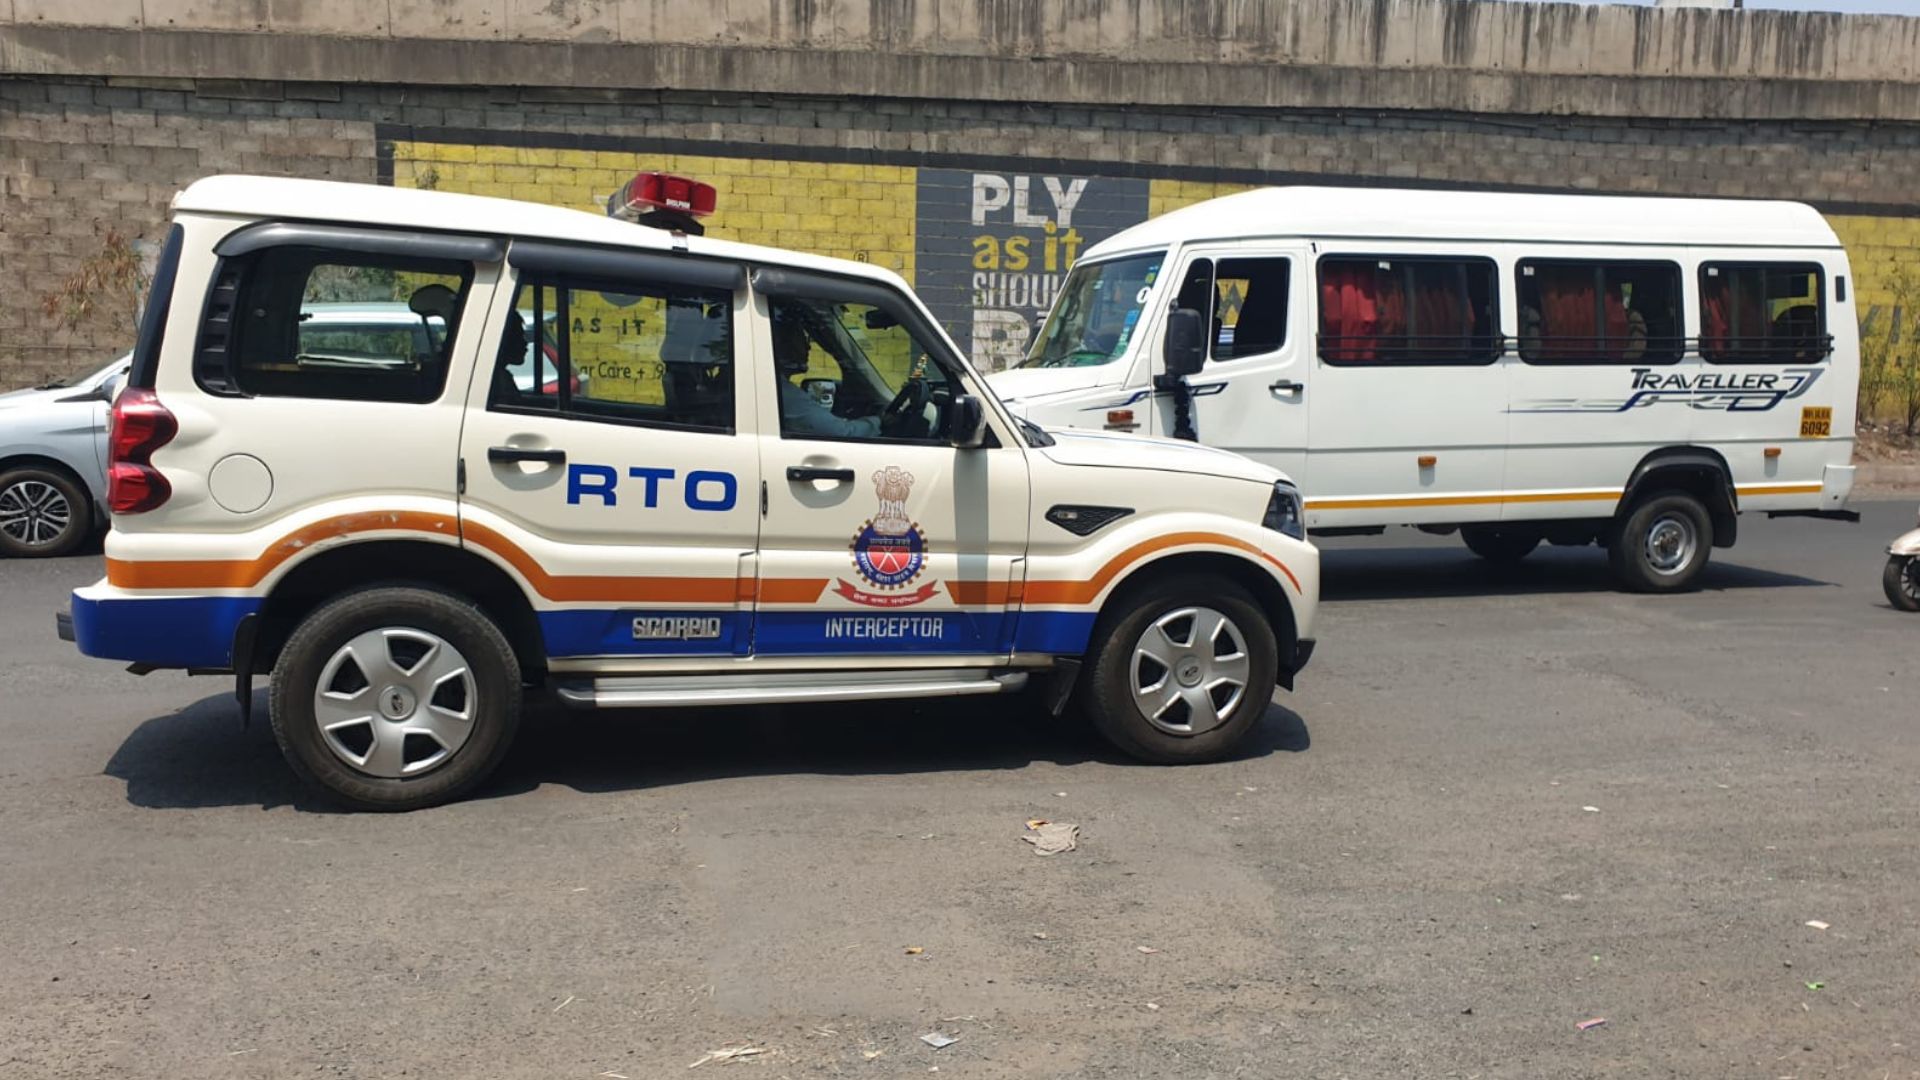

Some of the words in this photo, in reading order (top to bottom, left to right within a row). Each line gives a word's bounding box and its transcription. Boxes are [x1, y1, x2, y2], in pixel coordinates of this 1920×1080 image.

[971, 173, 1089, 229] PLY
[972, 235, 1031, 271] as
[1044, 220, 1084, 272] it
[571, 317, 602, 334] AS
[621, 318, 647, 336] IT
[579, 364, 595, 379] ar
[598, 360, 632, 379] Care
[1630, 367, 1780, 390] TRAVELLER
[1801, 420, 1830, 437] 6092
[566, 463, 738, 512] RTO
[632, 617, 721, 640] SCORPIO
[825, 617, 944, 639] INTERCEPTOR
